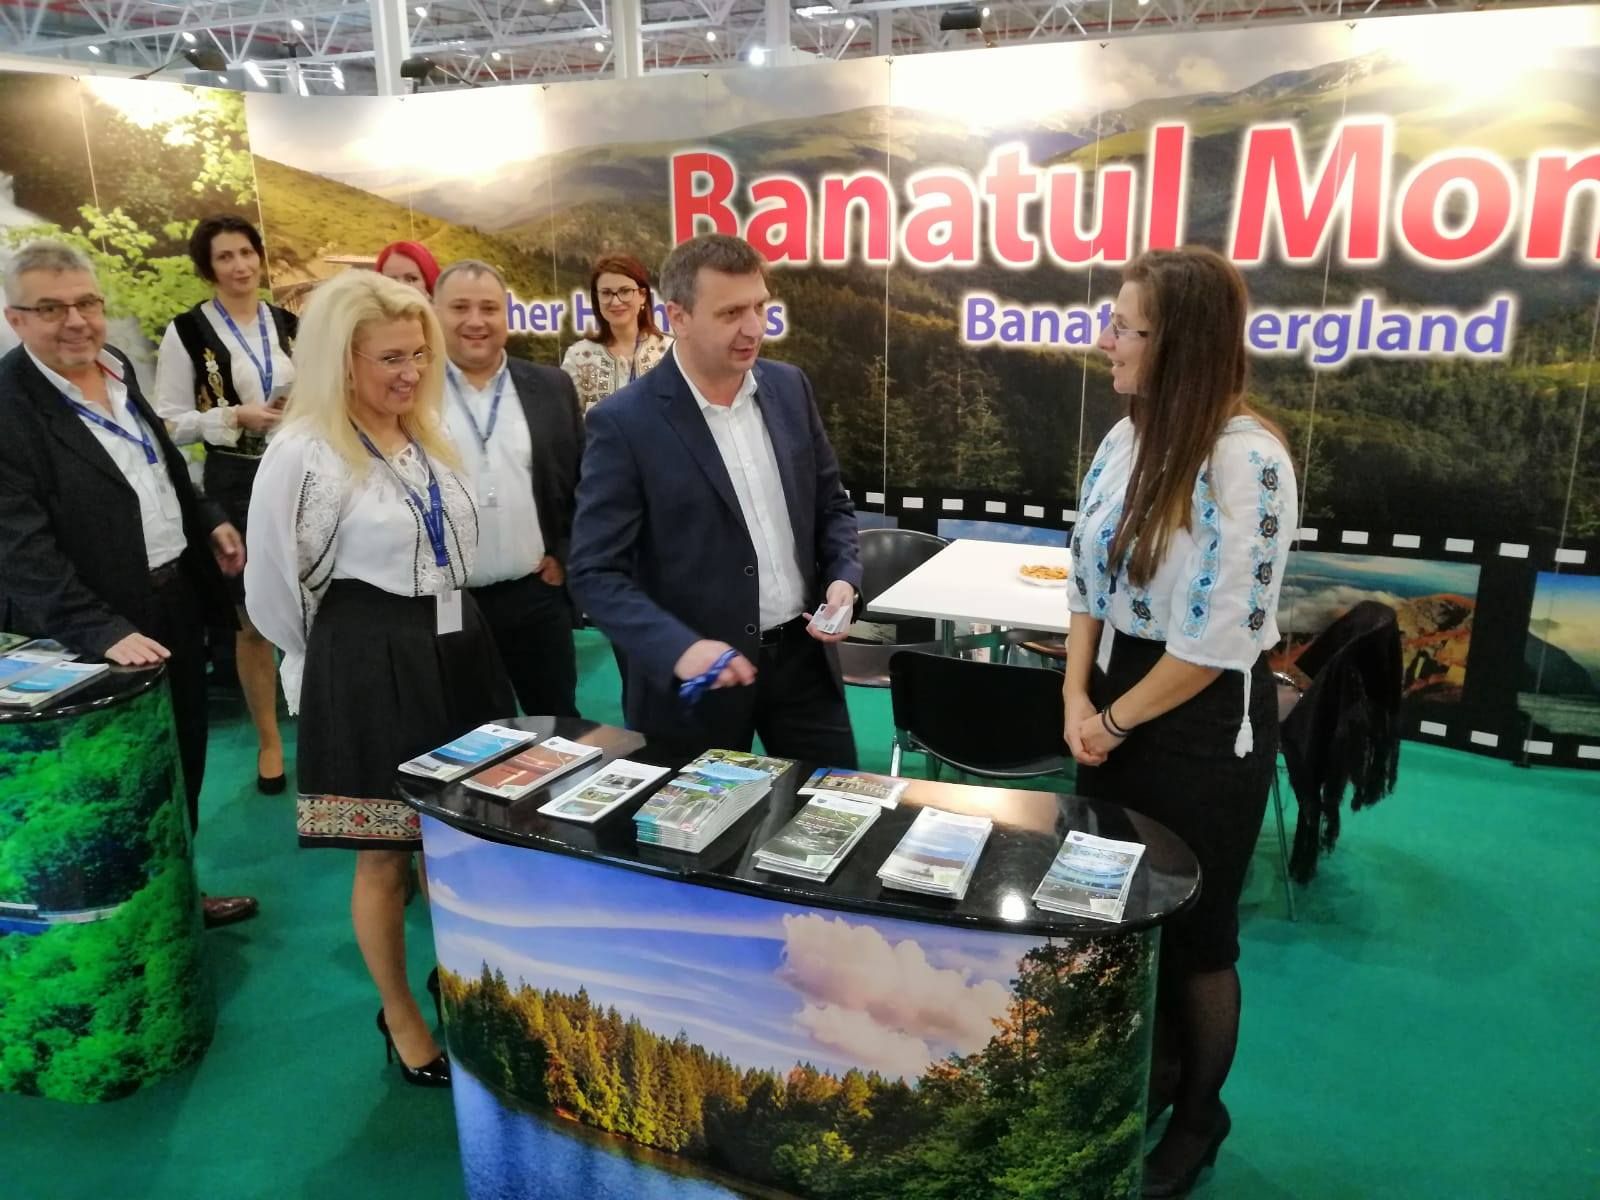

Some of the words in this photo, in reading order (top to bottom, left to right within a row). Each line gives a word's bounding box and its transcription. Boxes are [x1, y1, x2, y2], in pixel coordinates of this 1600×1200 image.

[672, 126, 1185, 263] Banatul
[1232, 124, 1600, 261] Mon
[506, 292, 564, 331] her
[1248, 298, 1510, 364] ergland
